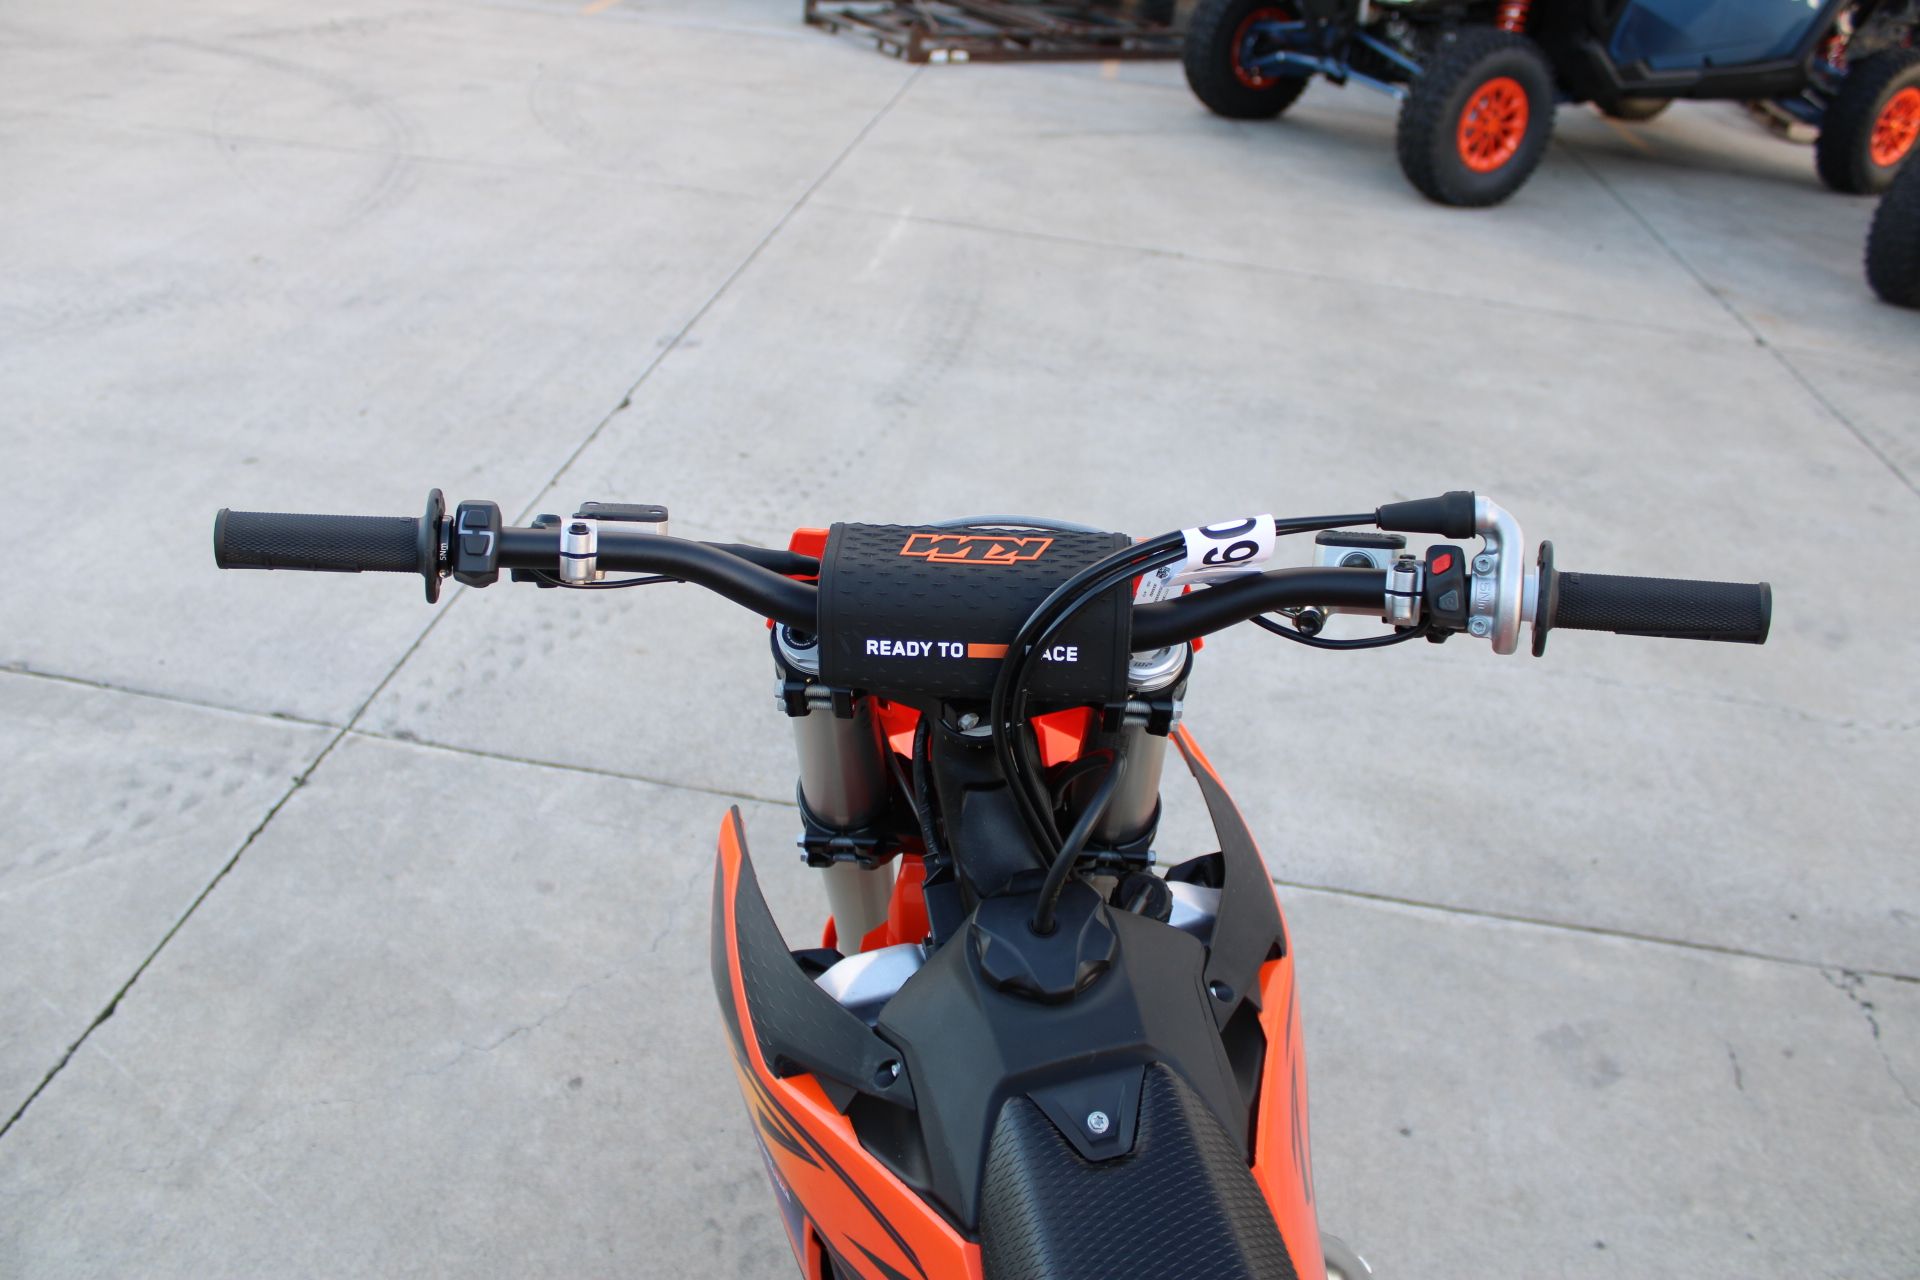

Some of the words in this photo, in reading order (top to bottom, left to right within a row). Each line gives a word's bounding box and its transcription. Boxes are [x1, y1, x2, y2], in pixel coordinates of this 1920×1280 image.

[900, 533, 1055, 565] KTM
[866, 639, 933, 657] READY
[938, 642, 964, 658] TO
